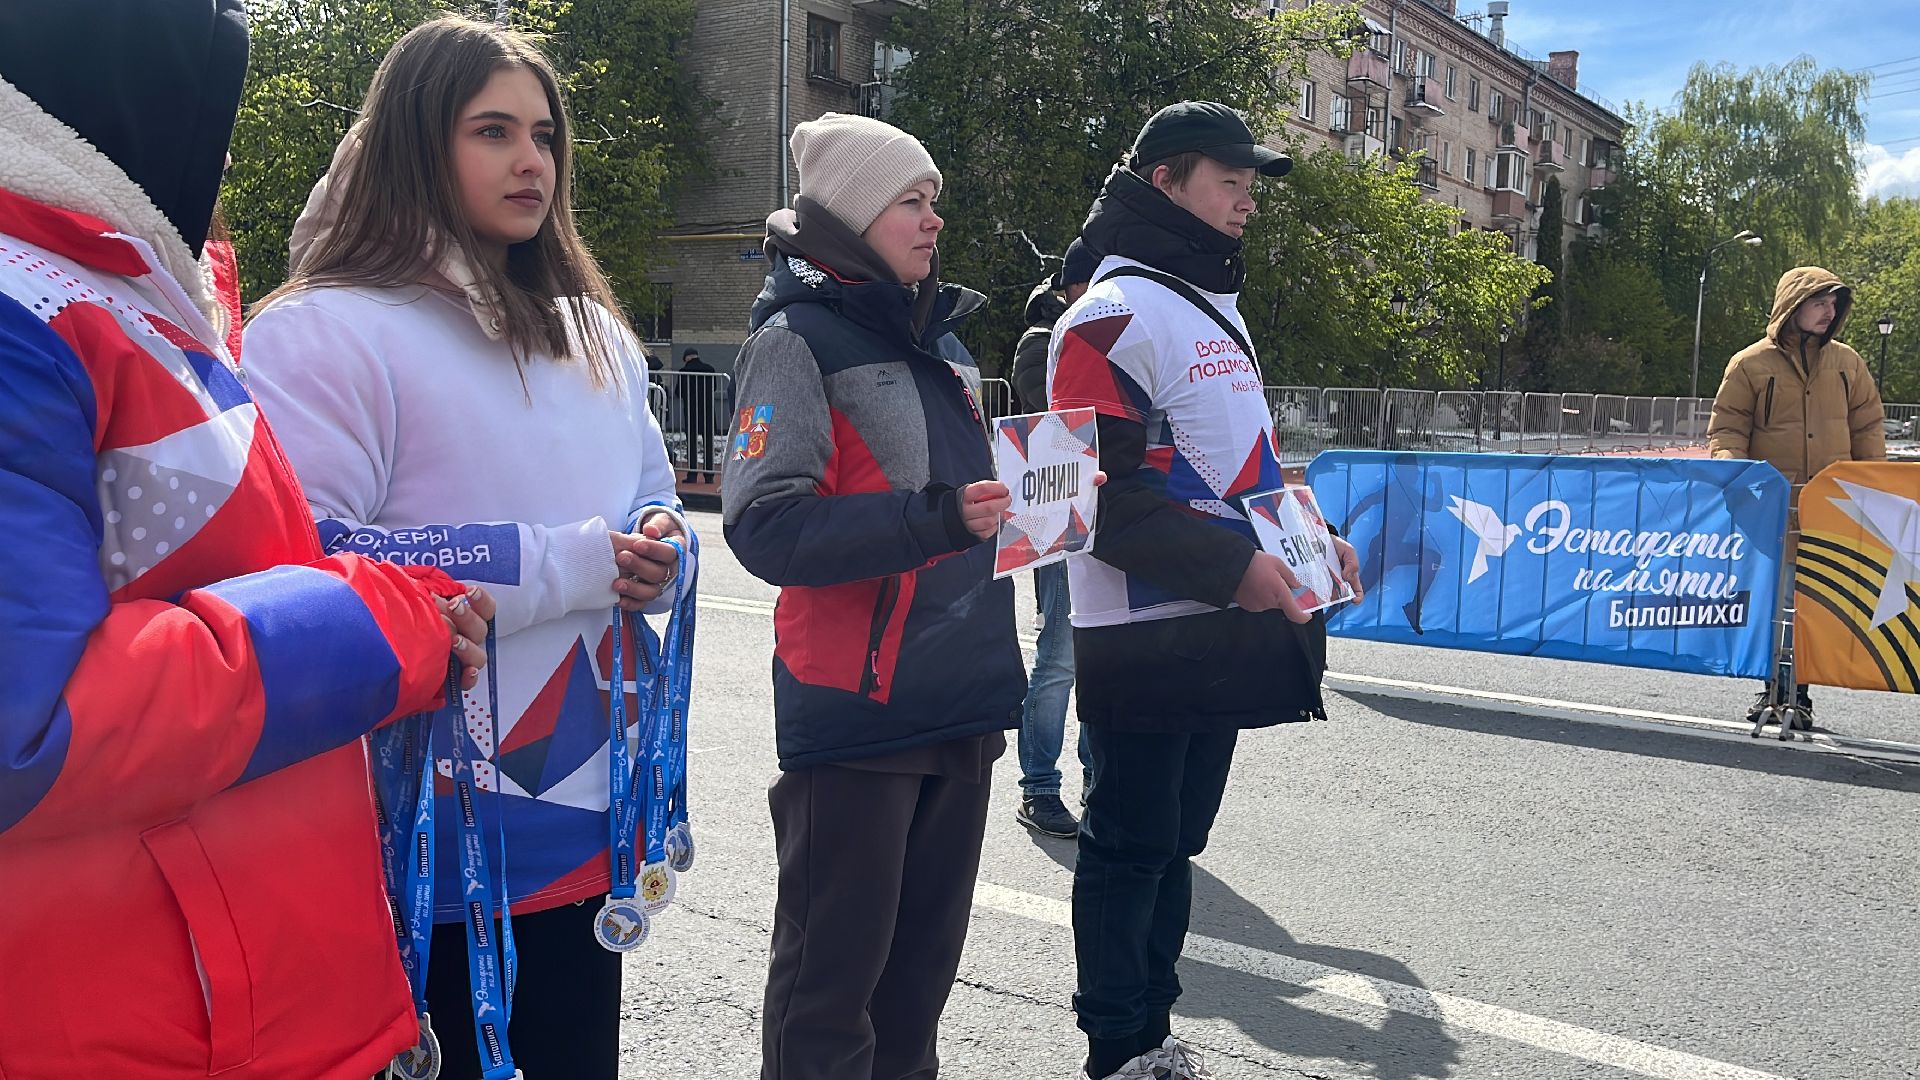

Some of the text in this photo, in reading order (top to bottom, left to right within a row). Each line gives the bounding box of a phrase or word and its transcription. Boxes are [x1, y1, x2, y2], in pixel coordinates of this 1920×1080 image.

[1195, 340, 1241, 358] ВОЛО
[1022, 461, 1079, 506] ФИНИШ
[1280, 538, 1298, 568] 5
[1524, 500, 1745, 568] Эстафета
[1573, 567, 1739, 599] памяти
[1609, 600, 1744, 627] Балашиха
[461, 783, 474, 827] Балашиха
[419, 834, 428, 878] Балашиха
[473, 902, 488, 947] Балашиха
[485, 1025, 503, 1067] Балашиха
